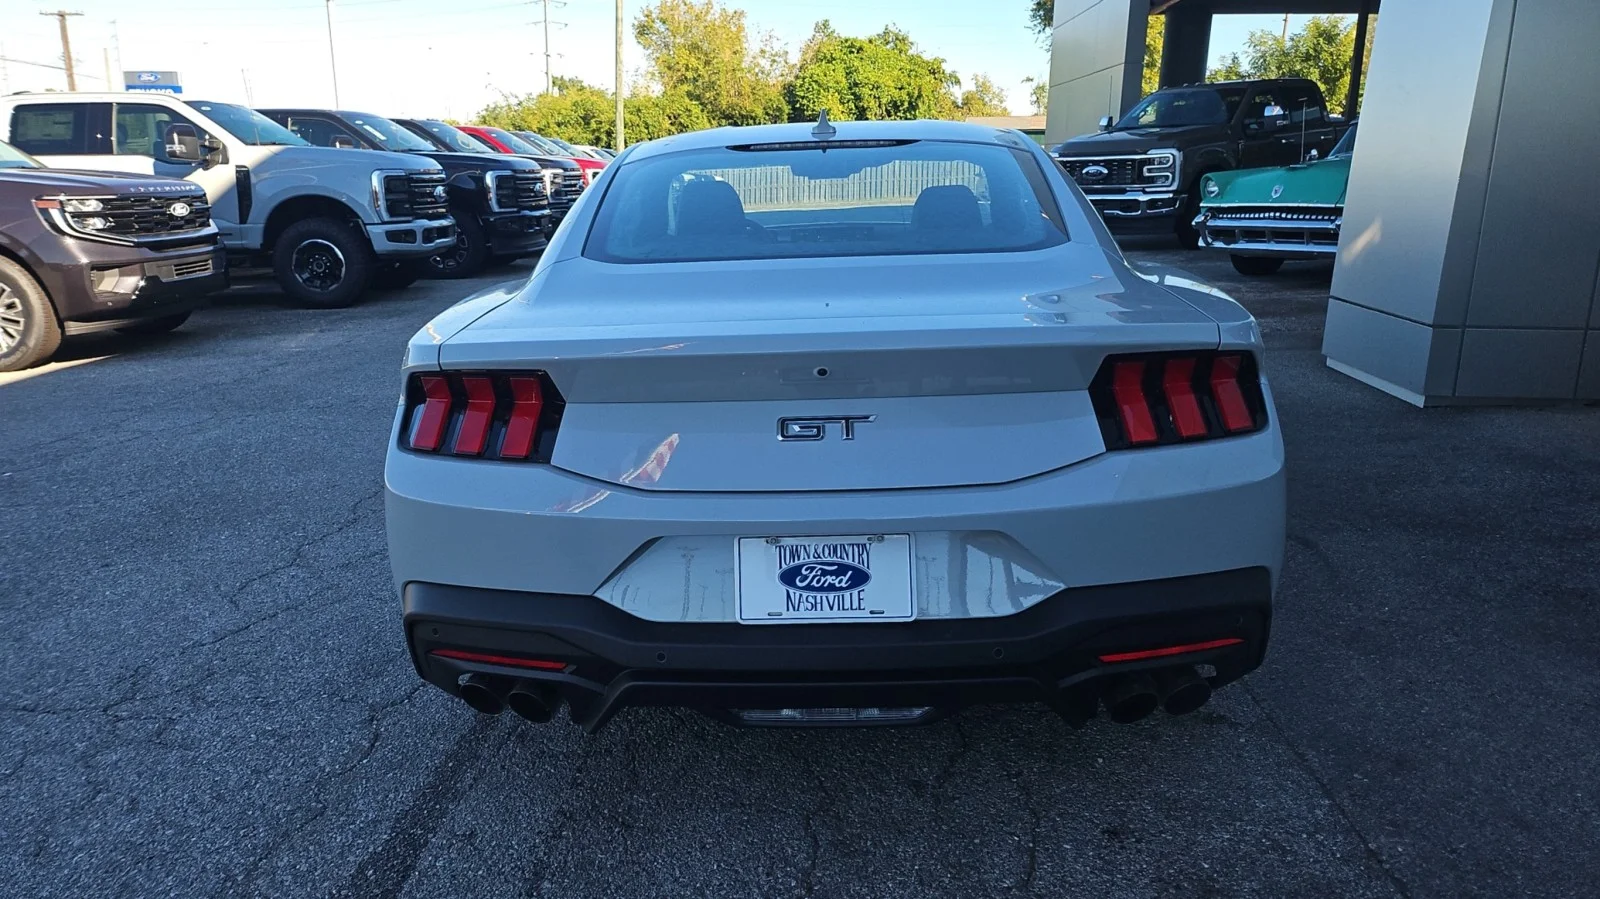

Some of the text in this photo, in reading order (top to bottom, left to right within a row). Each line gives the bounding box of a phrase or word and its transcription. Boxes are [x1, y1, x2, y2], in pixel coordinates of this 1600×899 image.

[777, 415, 877, 441] GT
[775, 544, 811, 570] TOWN
[821, 543, 872, 570] COUNTRY
[795, 564, 852, 588] Ford
[785, 588, 866, 612] NASHVILLE
